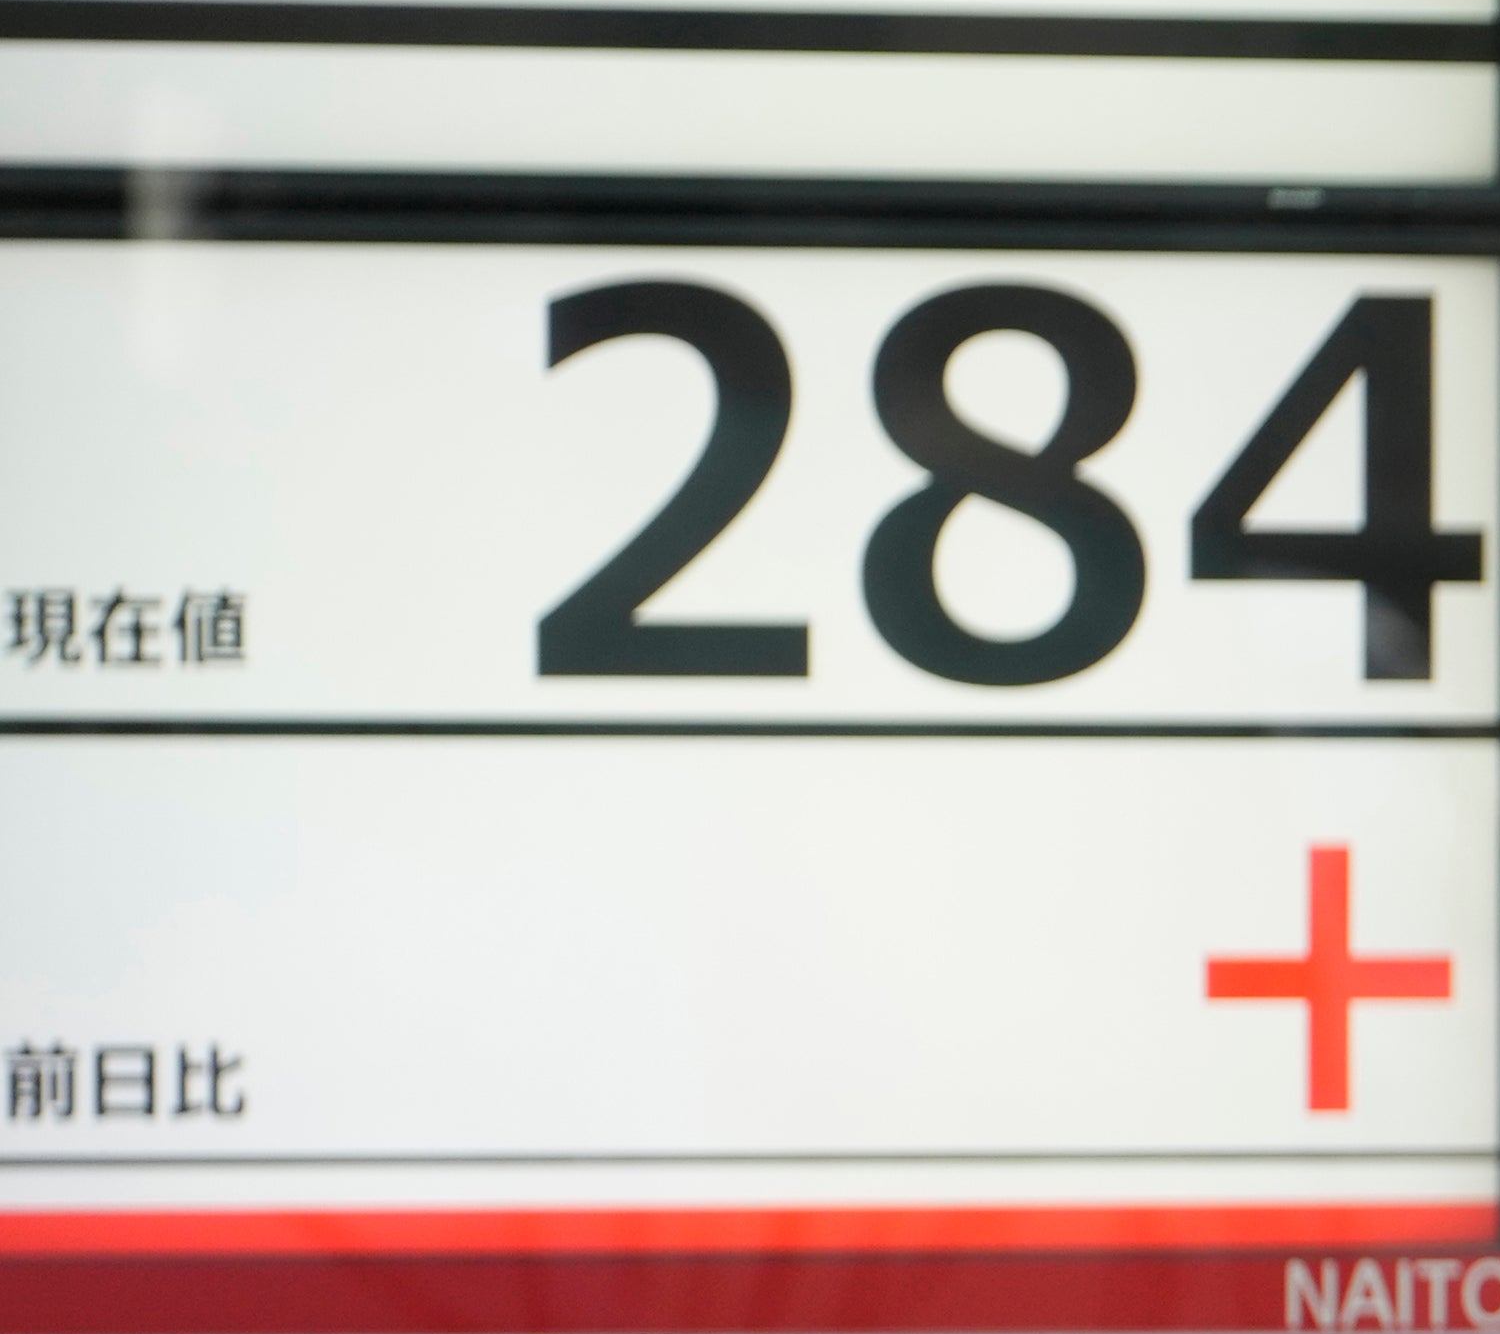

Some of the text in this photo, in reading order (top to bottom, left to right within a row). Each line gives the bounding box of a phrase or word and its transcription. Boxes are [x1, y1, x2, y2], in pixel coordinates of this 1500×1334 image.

[4, 586, 248, 669] 現在値
[4, 1038, 246, 1121] 前日比
